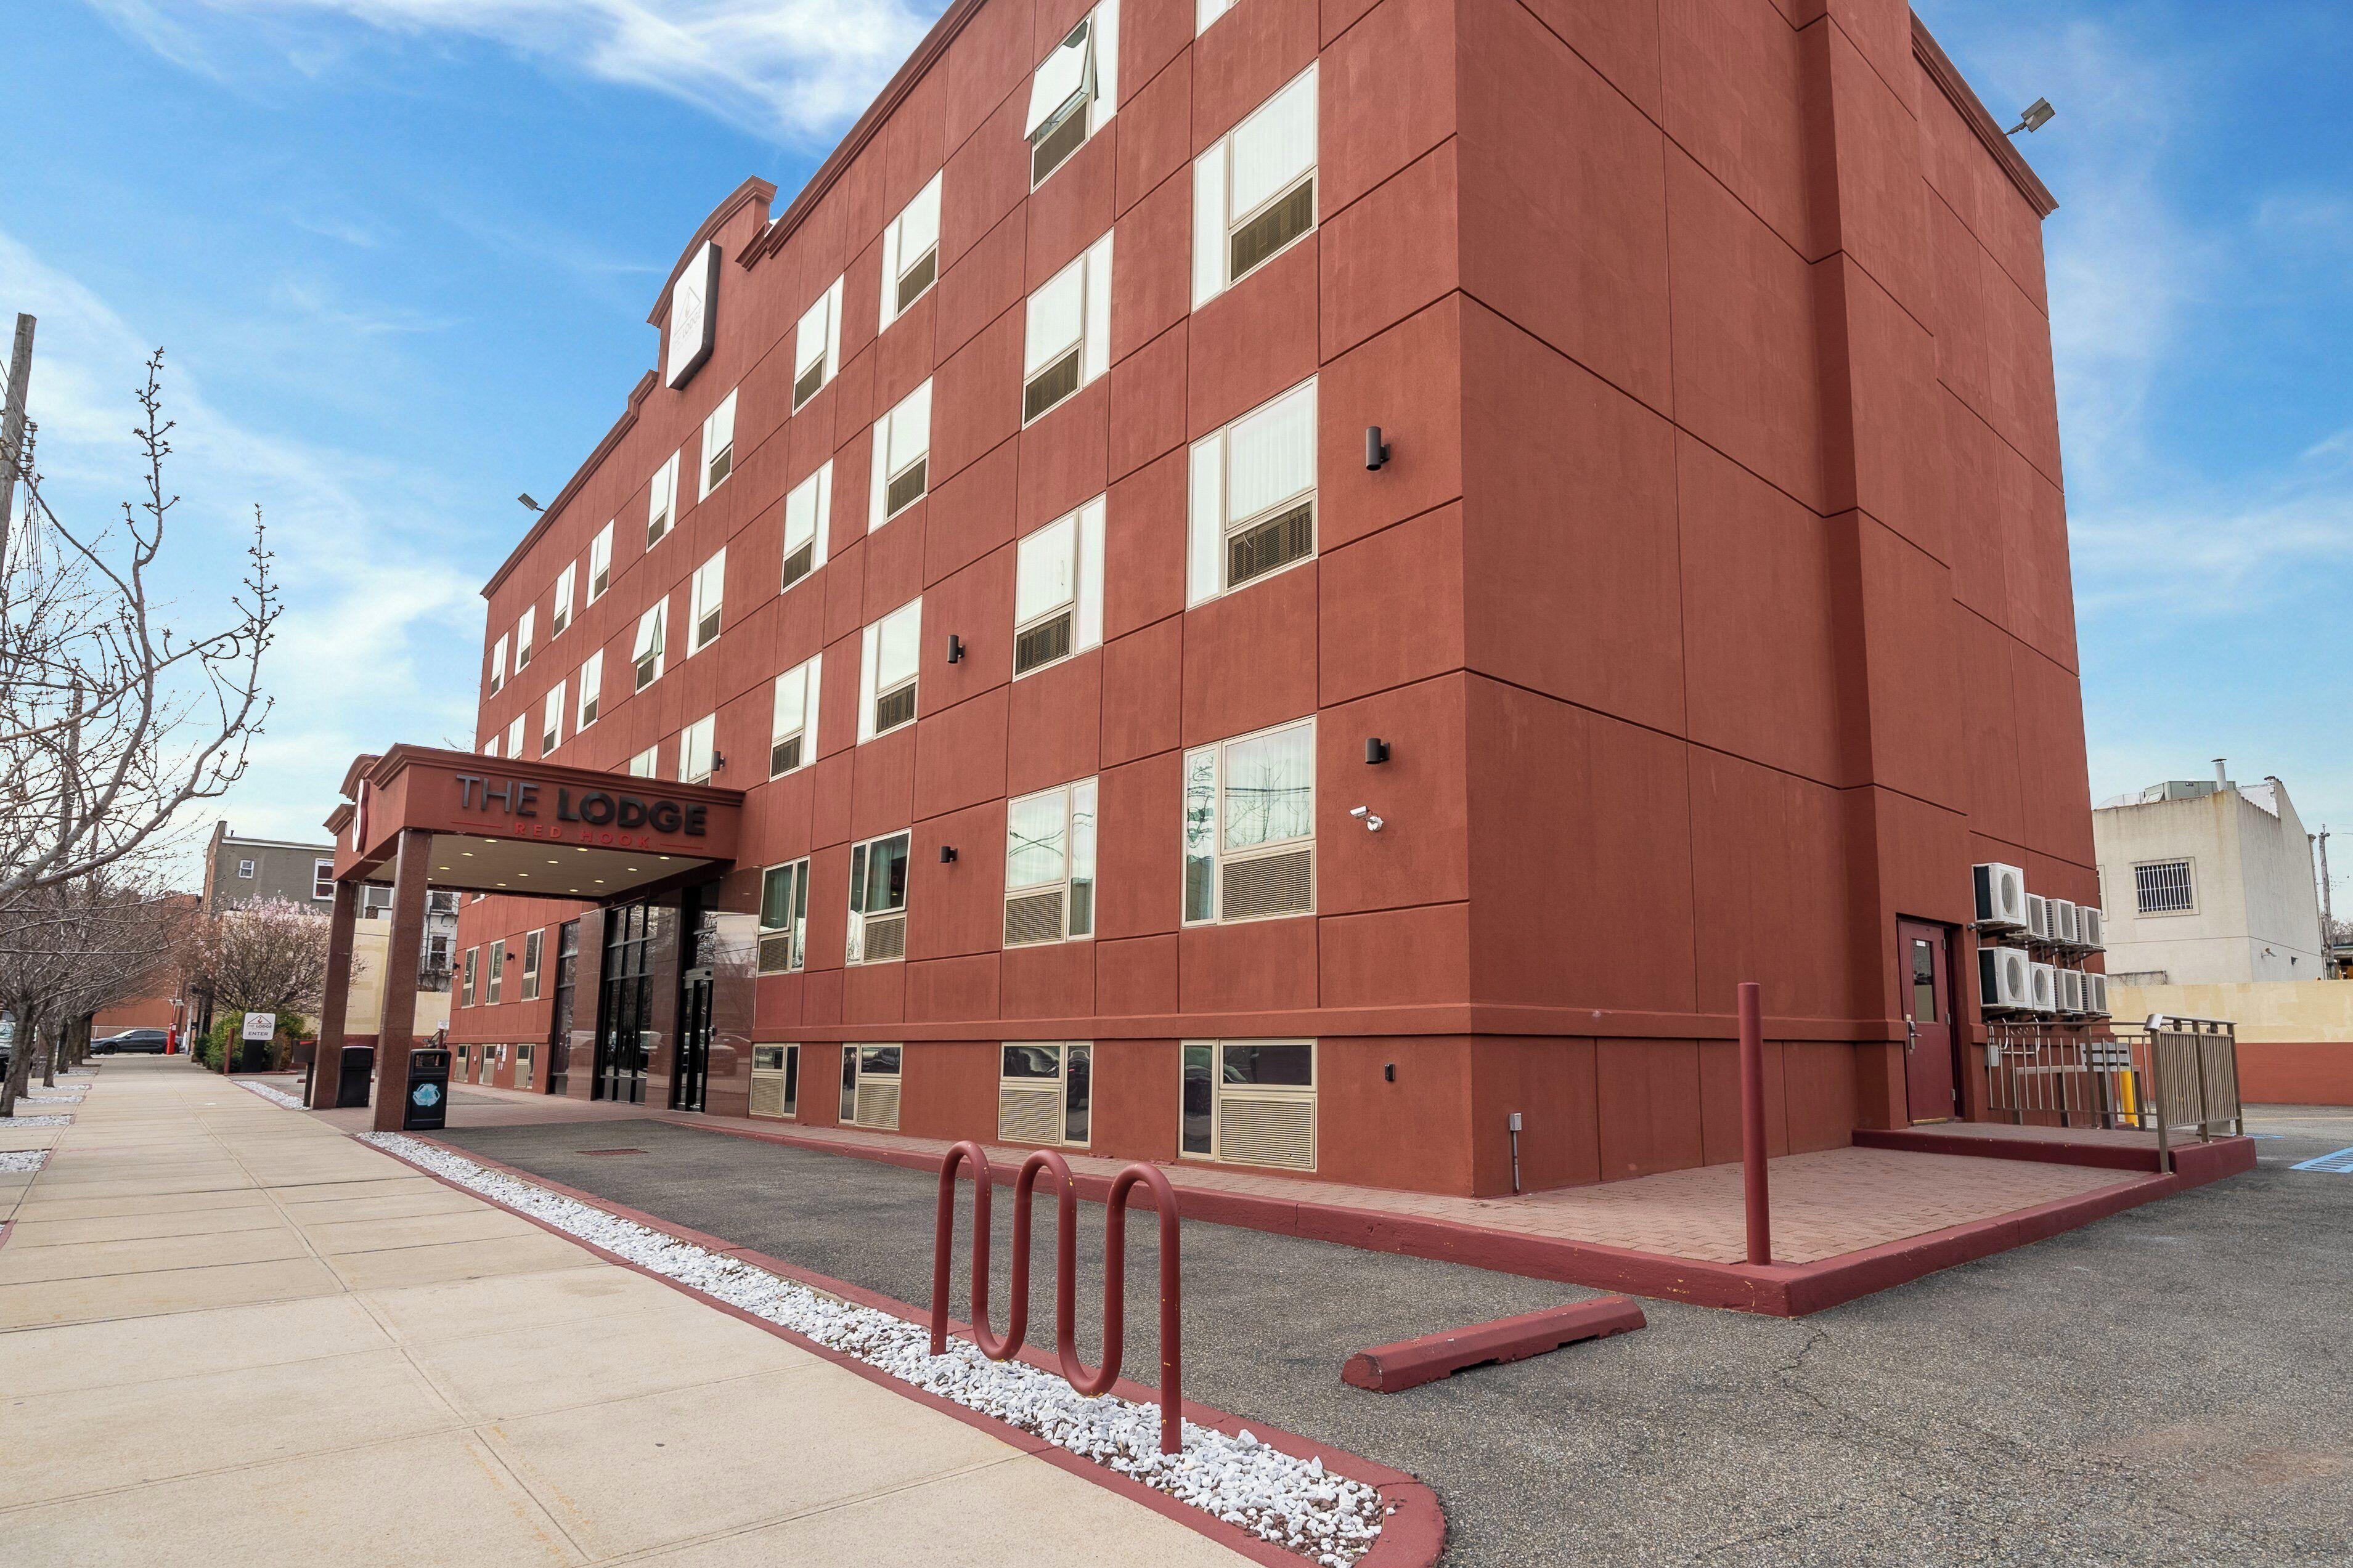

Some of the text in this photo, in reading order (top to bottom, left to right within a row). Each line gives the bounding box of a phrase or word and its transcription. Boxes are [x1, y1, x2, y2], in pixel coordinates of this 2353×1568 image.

[456, 774, 707, 836] THE LODGE
[514, 822, 650, 848] RED HOOK
